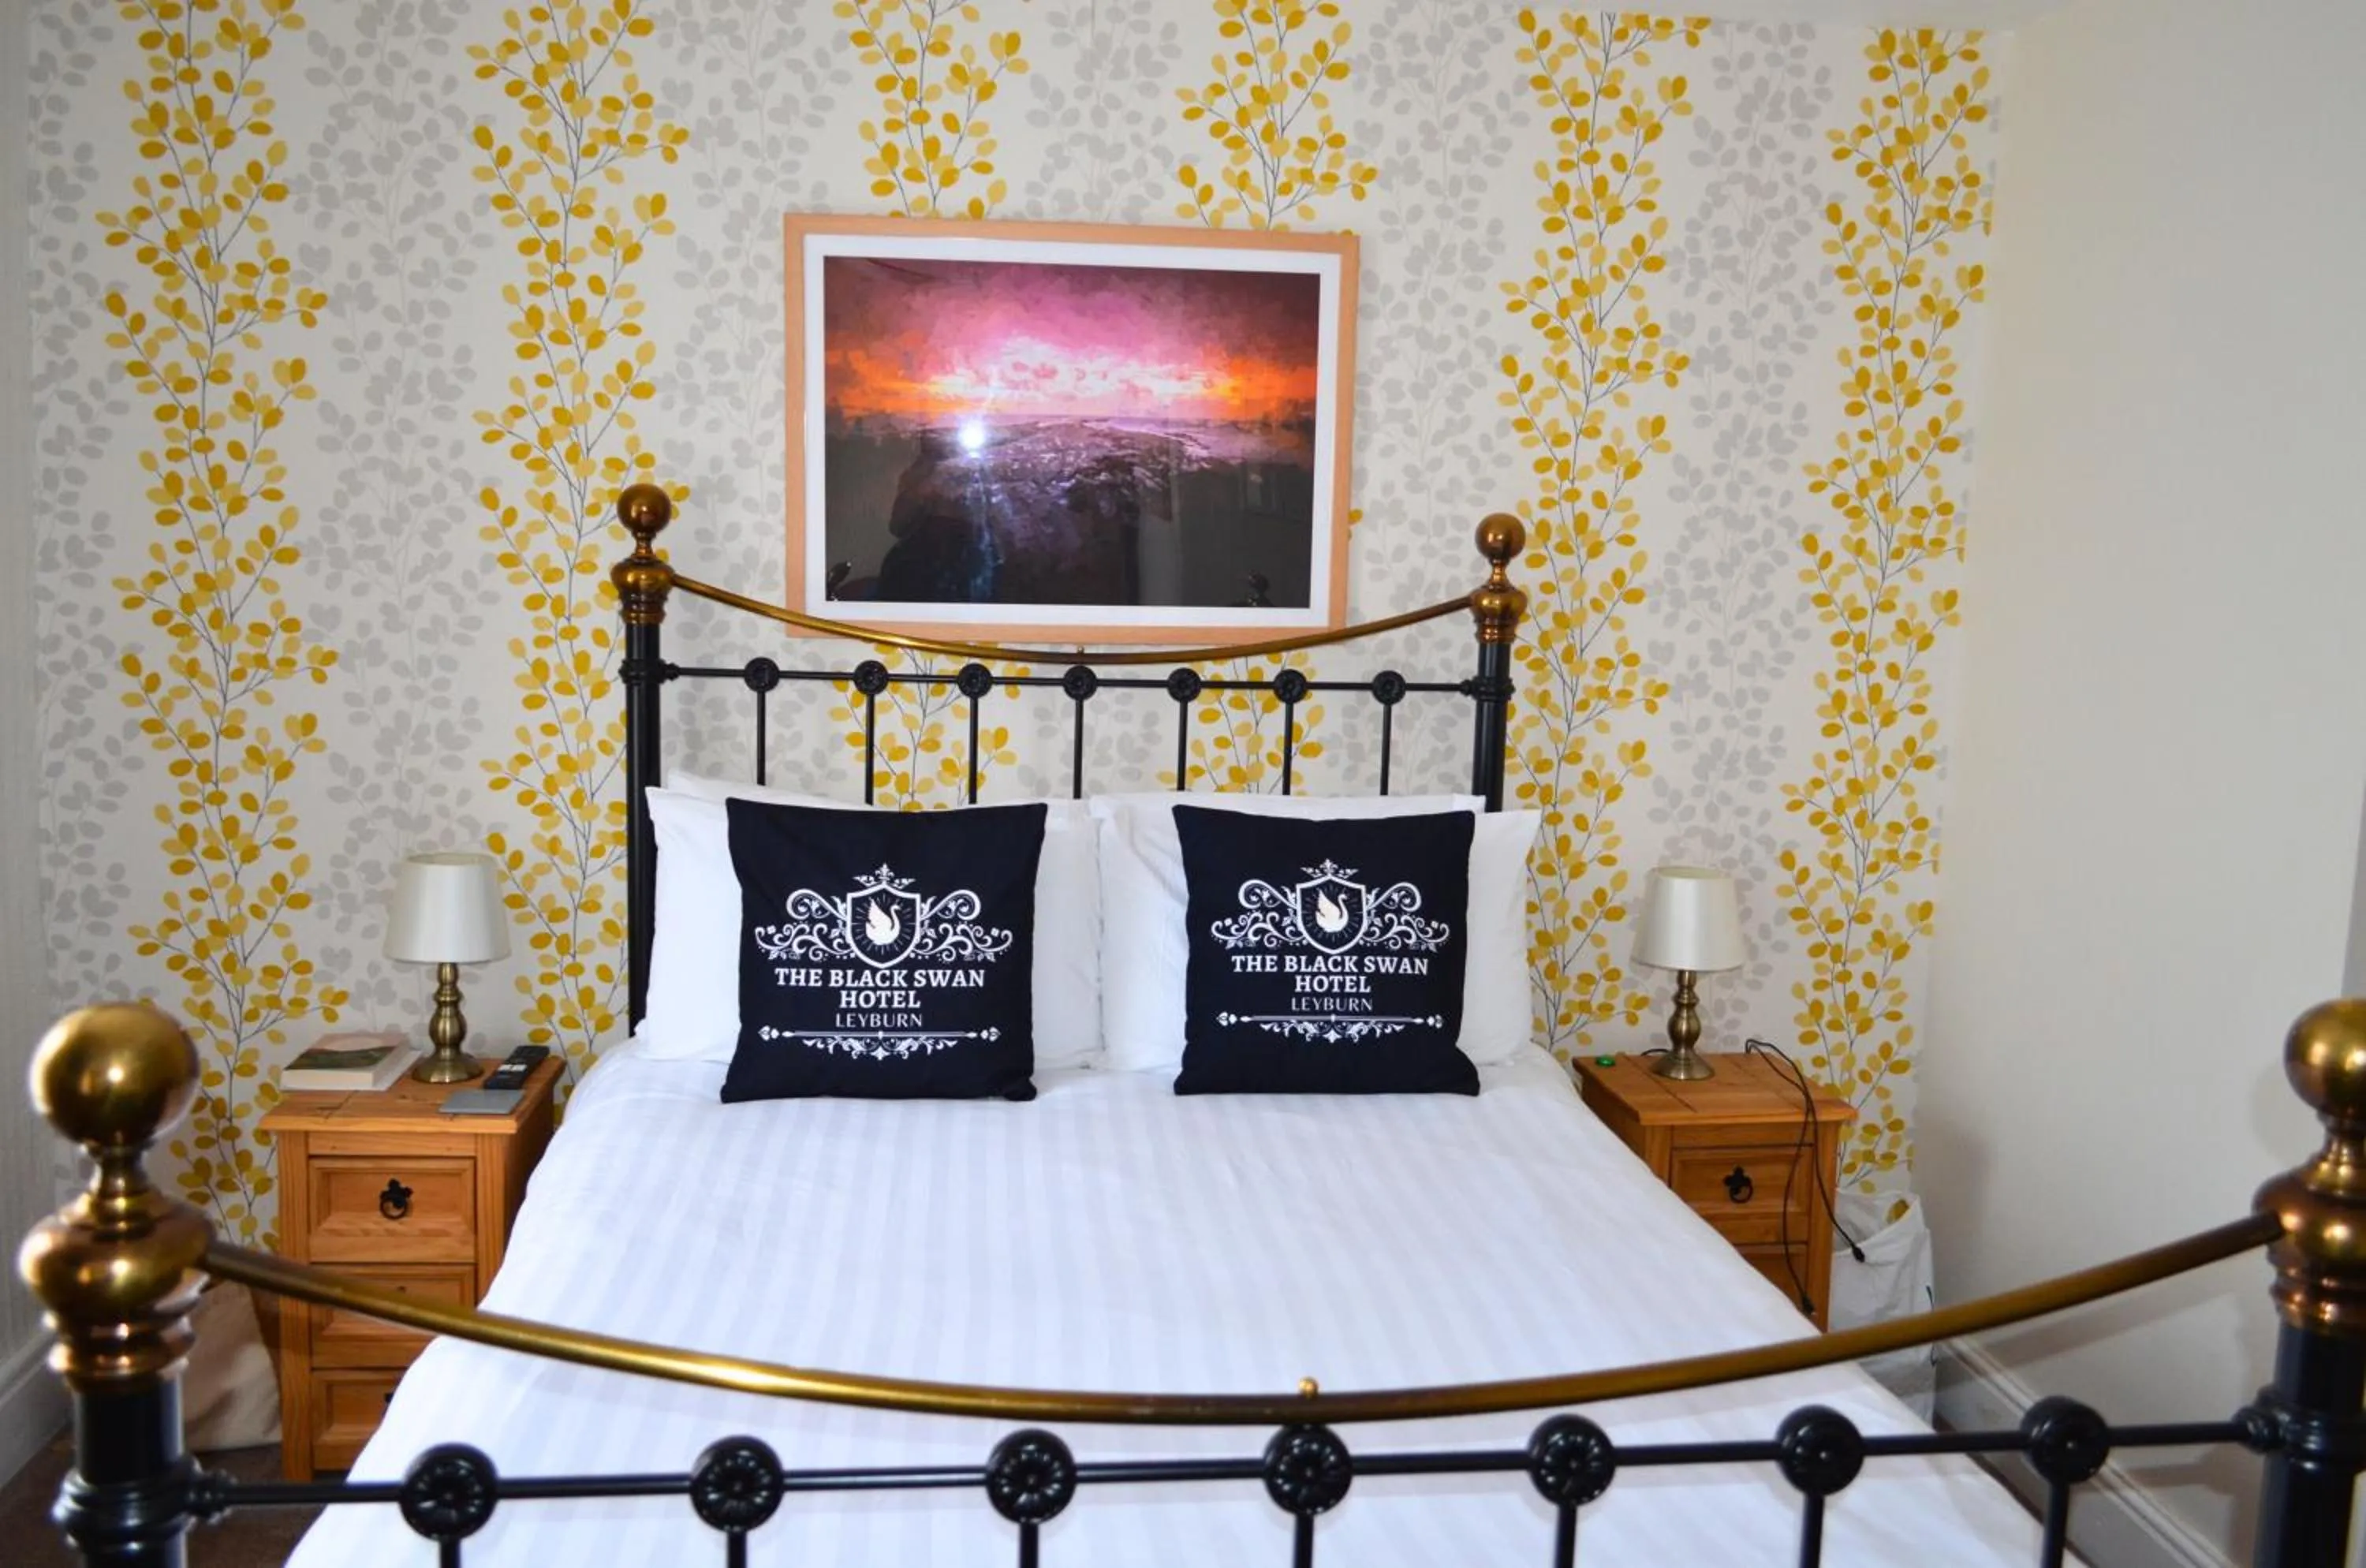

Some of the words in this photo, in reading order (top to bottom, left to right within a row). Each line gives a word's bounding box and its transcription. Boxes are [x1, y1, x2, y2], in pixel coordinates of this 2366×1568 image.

[1231, 955, 1278, 973] THE
[1284, 955, 1358, 973] BLACK
[1364, 956, 1428, 976] SWAN
[774, 968, 823, 987] THE
[829, 969, 909, 987] BLACK
[913, 969, 985, 987] SWAN
[1294, 975, 1371, 993] HOTEL
[839, 990, 921, 1009] HOTEL
[1291, 997, 1373, 1011] LEYBURN
[836, 1013, 923, 1028] LEYBURN
